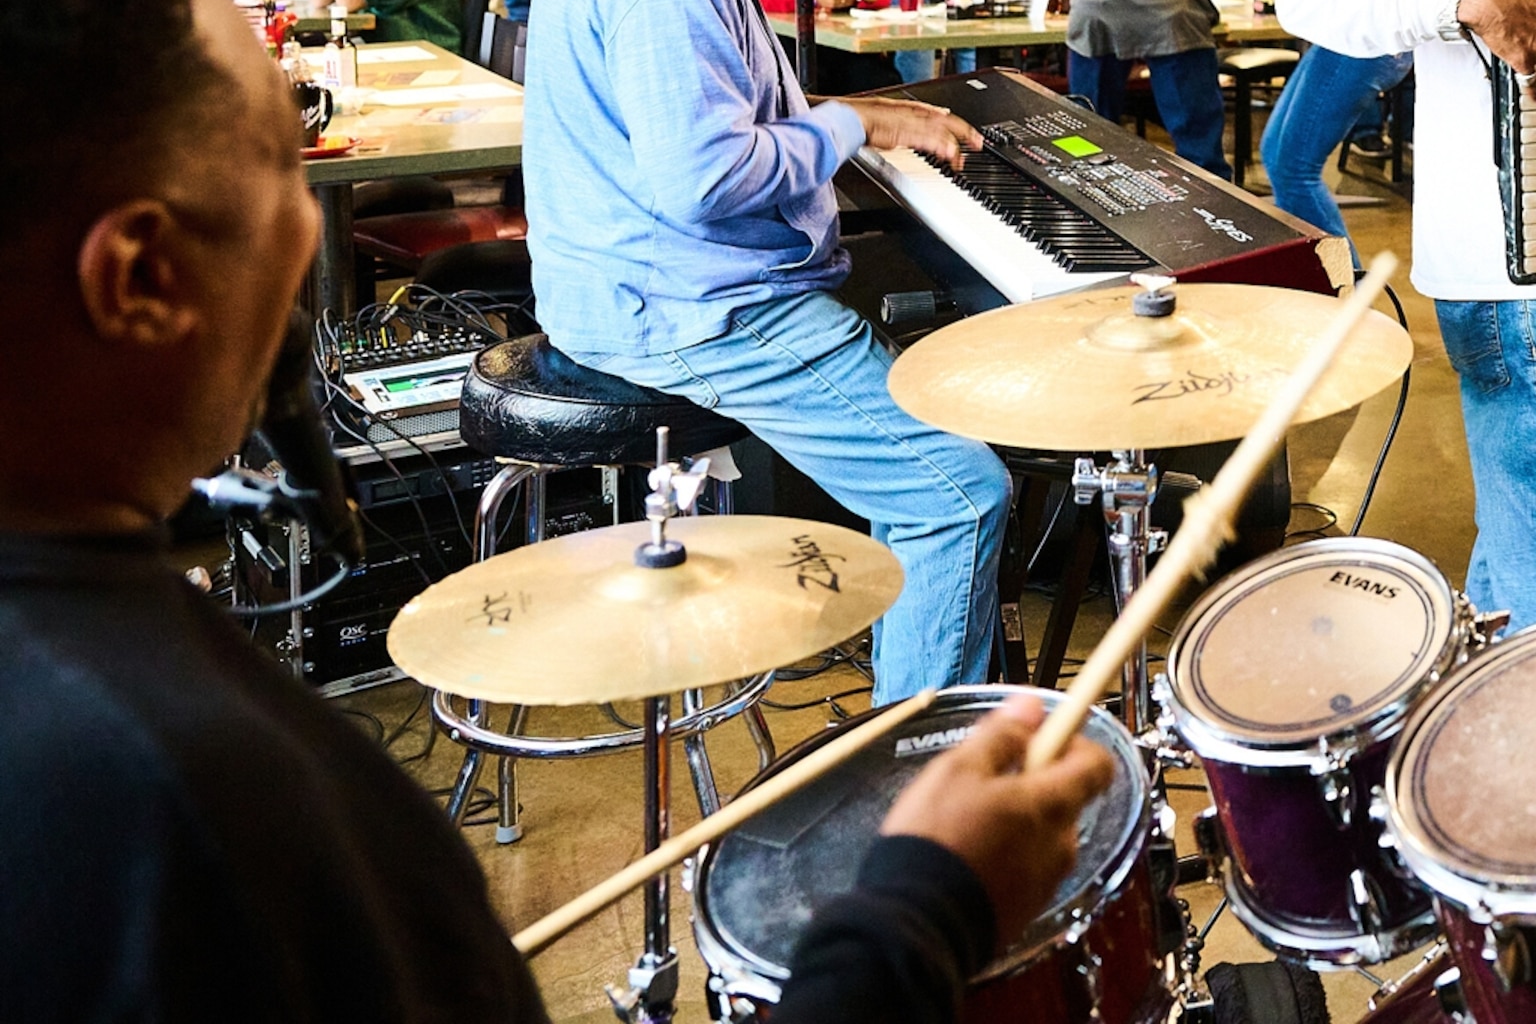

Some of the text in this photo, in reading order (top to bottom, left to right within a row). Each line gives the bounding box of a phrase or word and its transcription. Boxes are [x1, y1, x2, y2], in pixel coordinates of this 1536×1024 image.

[1131, 369, 1293, 406] Zildjin
[1329, 571, 1402, 598] EVANS
[339, 622, 367, 641] QSC
